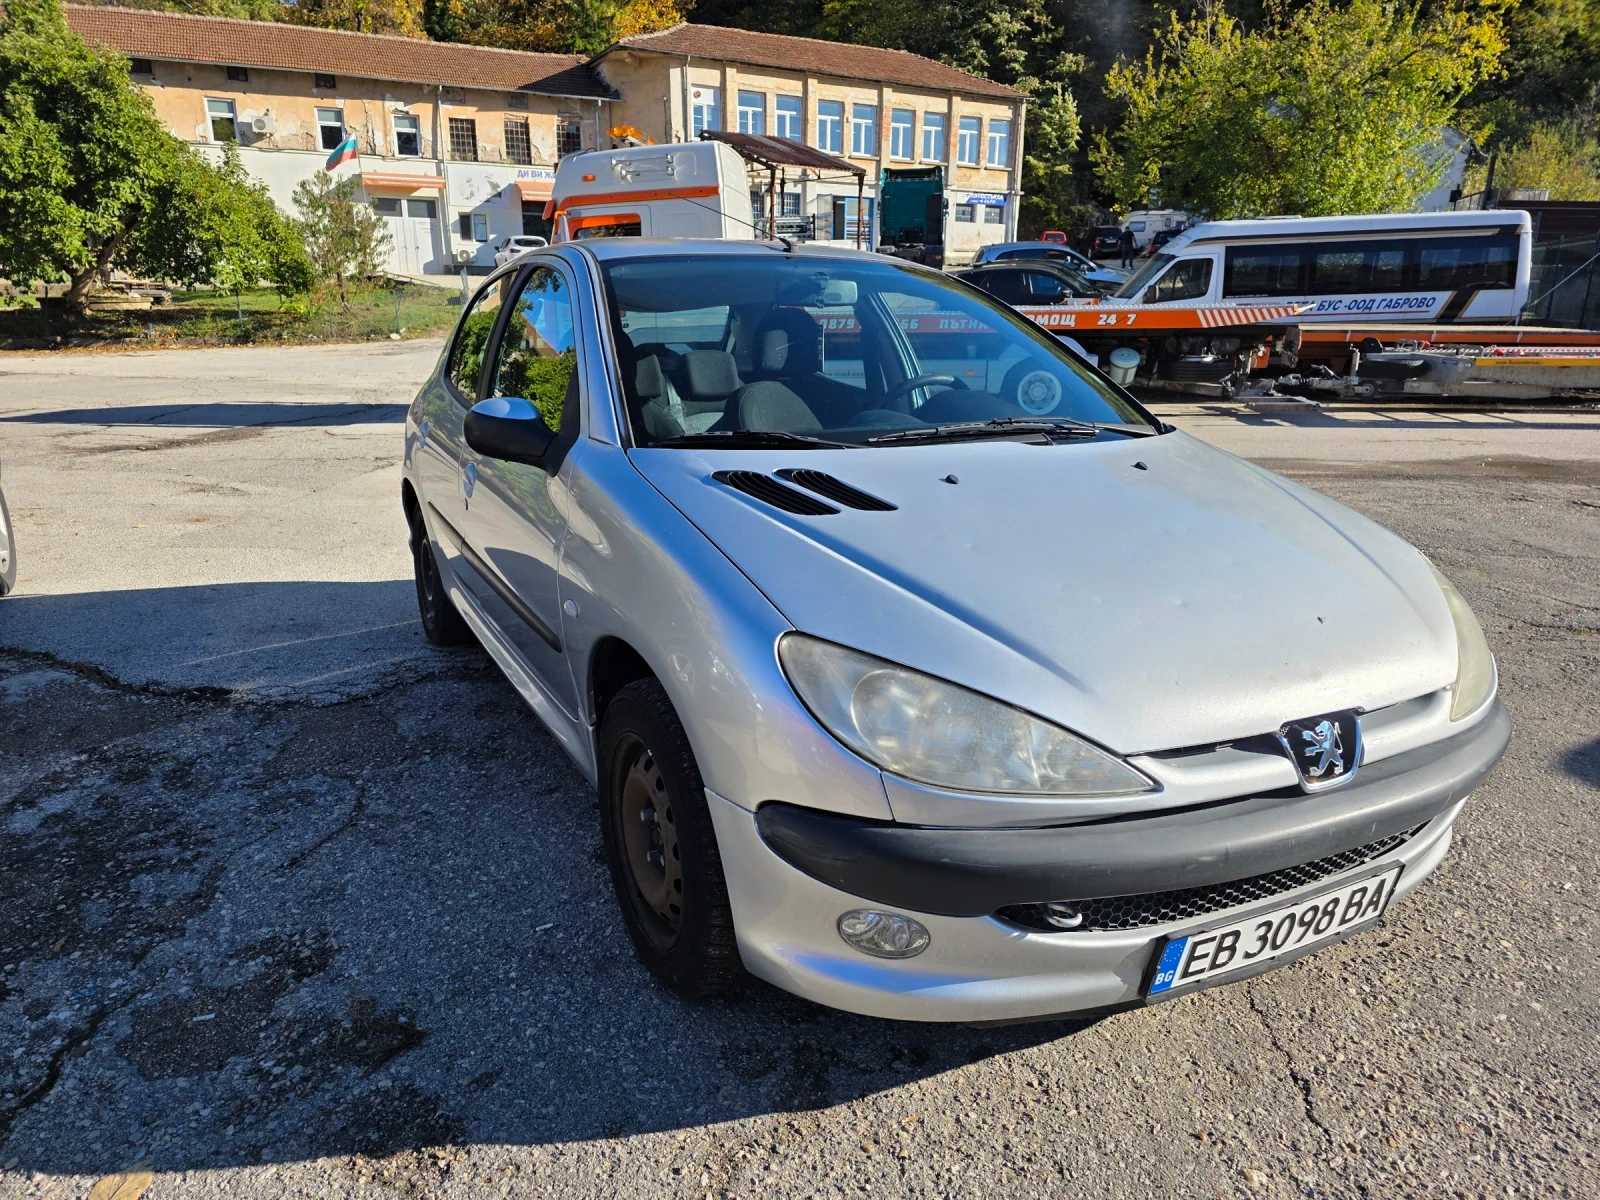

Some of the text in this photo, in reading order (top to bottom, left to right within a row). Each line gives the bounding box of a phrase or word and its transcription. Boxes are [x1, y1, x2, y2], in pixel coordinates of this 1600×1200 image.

[517, 170, 529, 178] ДИ
[530, 170, 543, 178] ВИ
[1316, 300, 1342, 311] БУС
[1376, 297, 1436, 310] ГАБРОВО
[1097, 314, 1117, 325] 24
[1126, 314, 1137, 325] 7
[1180, 878, 1387, 980] EB 3098 BA
[1155, 972, 1173, 985] BG
